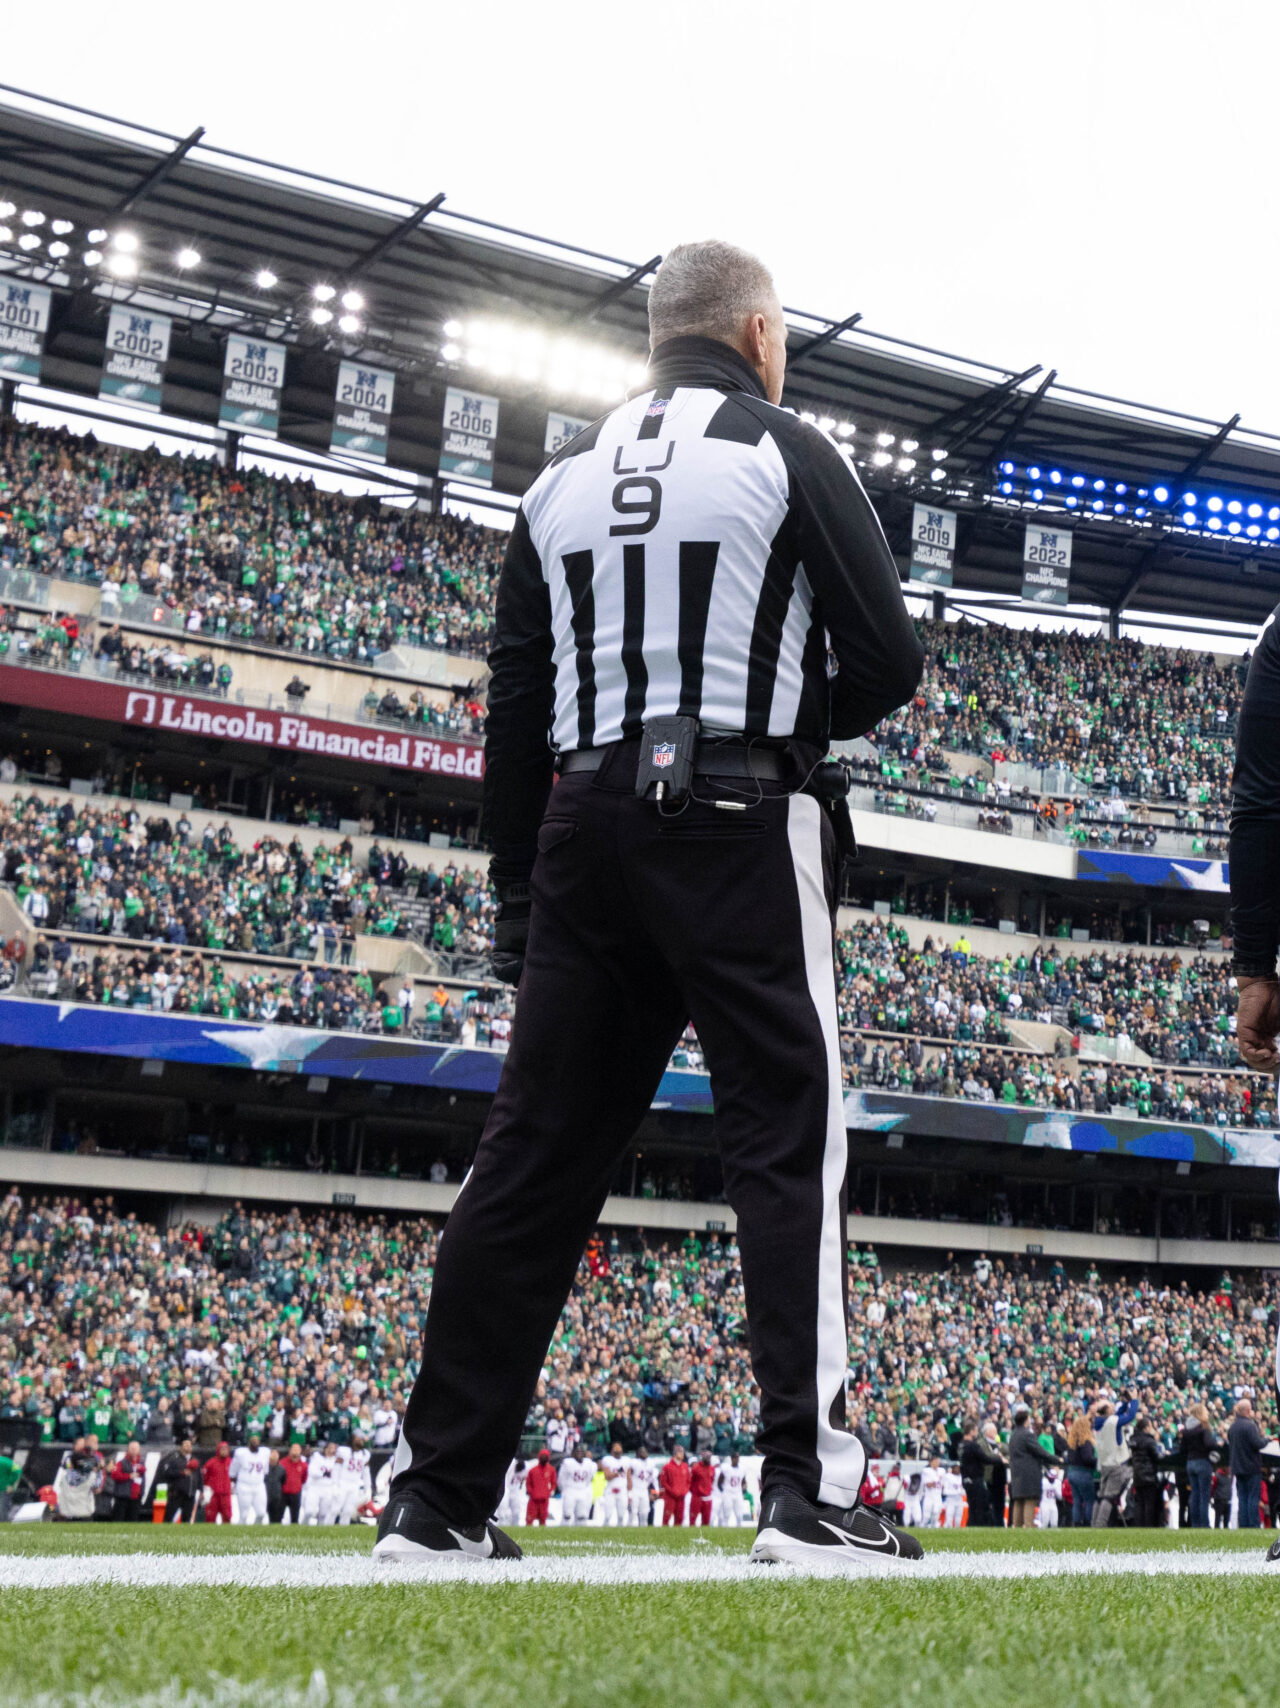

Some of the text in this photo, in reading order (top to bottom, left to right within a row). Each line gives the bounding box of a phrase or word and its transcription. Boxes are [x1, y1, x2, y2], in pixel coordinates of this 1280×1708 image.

[113, 331, 163, 356] 2002
[231, 358, 278, 383] 2003
[342, 384, 387, 410] 2004
[450, 411, 493, 434] 2006
[609, 476, 662, 537] 9
[918, 525, 950, 546] 2019
[914, 552, 951, 569] CHAMPIONS
[1029, 546, 1067, 566] 2022
[1025, 573, 1067, 588] CHAMPIONS
[1039, 567, 1054, 578] NFC
[160, 697, 483, 777] Lincoln Financial Field
[655, 753, 671, 765] NFL
